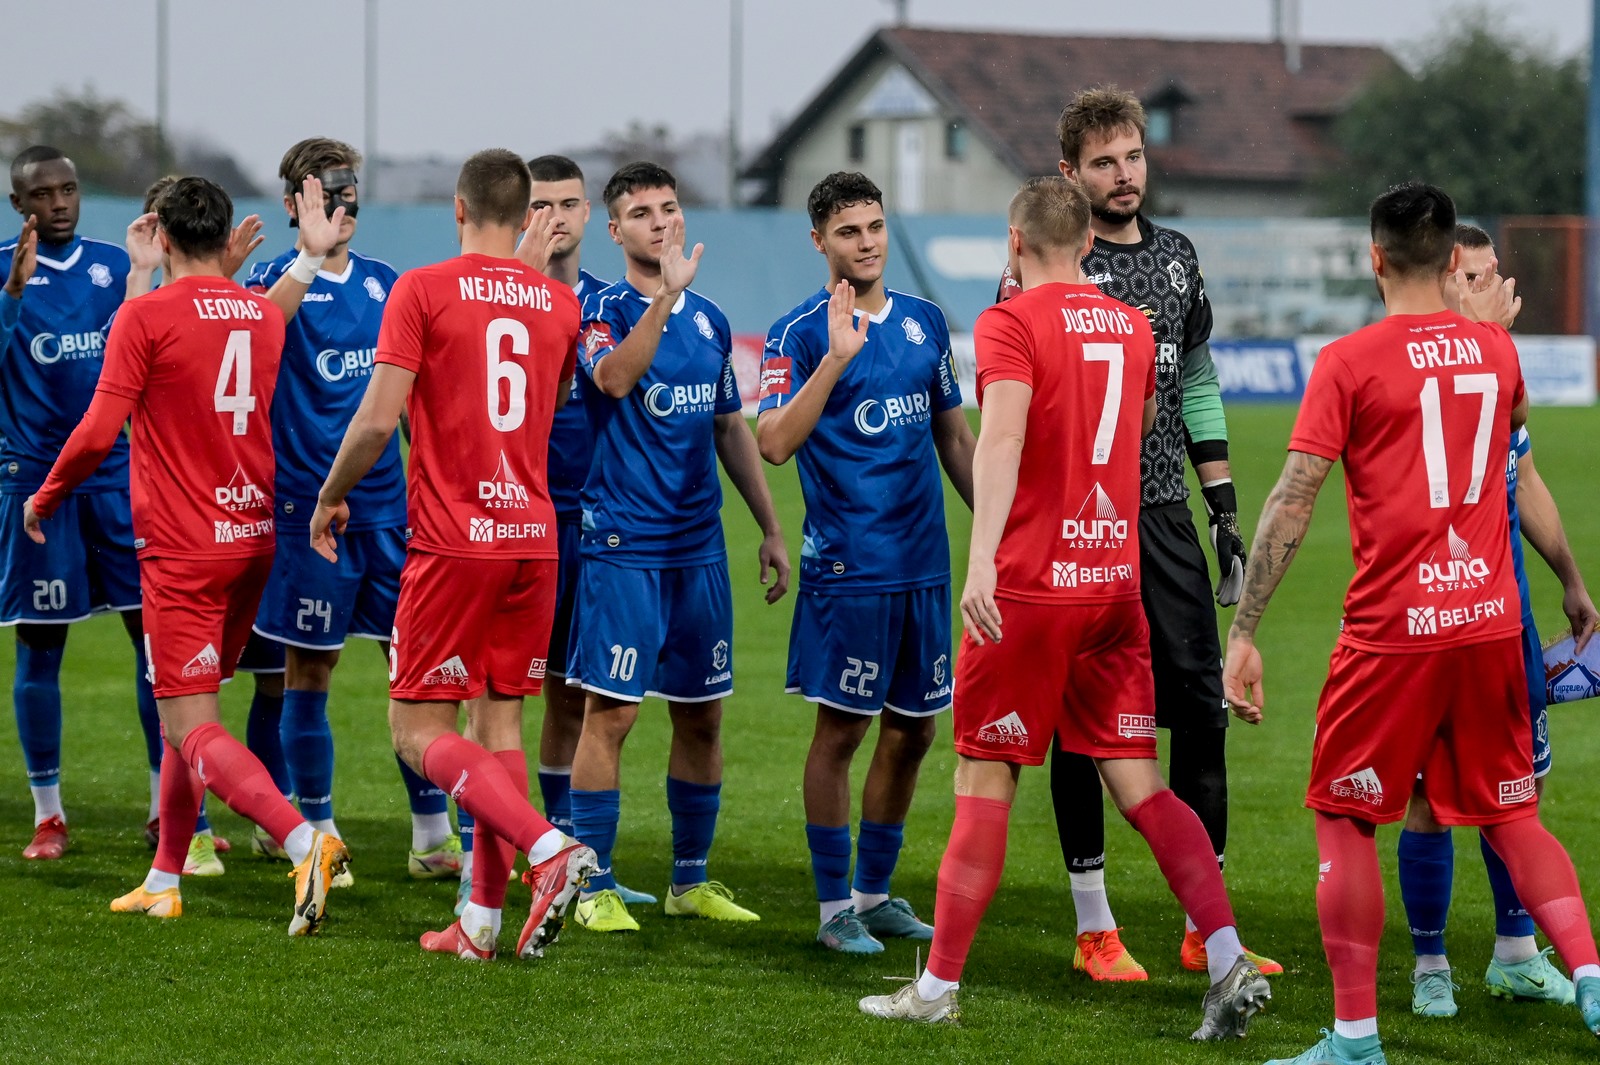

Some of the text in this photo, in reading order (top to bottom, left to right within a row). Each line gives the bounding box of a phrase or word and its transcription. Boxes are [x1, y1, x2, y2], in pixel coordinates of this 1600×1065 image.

[193, 298, 263, 320] LEOVAC
[302, 292, 334, 302] EGEA
[458, 275, 552, 312] NEJAŠMIĆ
[1061, 307, 1134, 335] JUGOVIĆ
[61, 331, 102, 353] BUR
[63, 350, 100, 361] VENTU
[1406, 333, 1483, 369] GRŽAN
[214, 330, 256, 436] 4
[486, 317, 529, 432] 6
[1082, 343, 1124, 465] 7
[1420, 373, 1499, 509] 17
[233, 518, 273, 538] BELFRY
[496, 523, 547, 538] BELFRY
[1069, 540, 1124, 549] ASZFALT
[1080, 563, 1133, 583] BELFRY
[1427, 577, 1485, 593] ASZFALT
[33, 579, 67, 610] 20
[296, 597, 332, 633] 24
[1439, 597, 1505, 628] BELFRY
[610, 644, 638, 682] 10
[839, 656, 880, 697] 22
